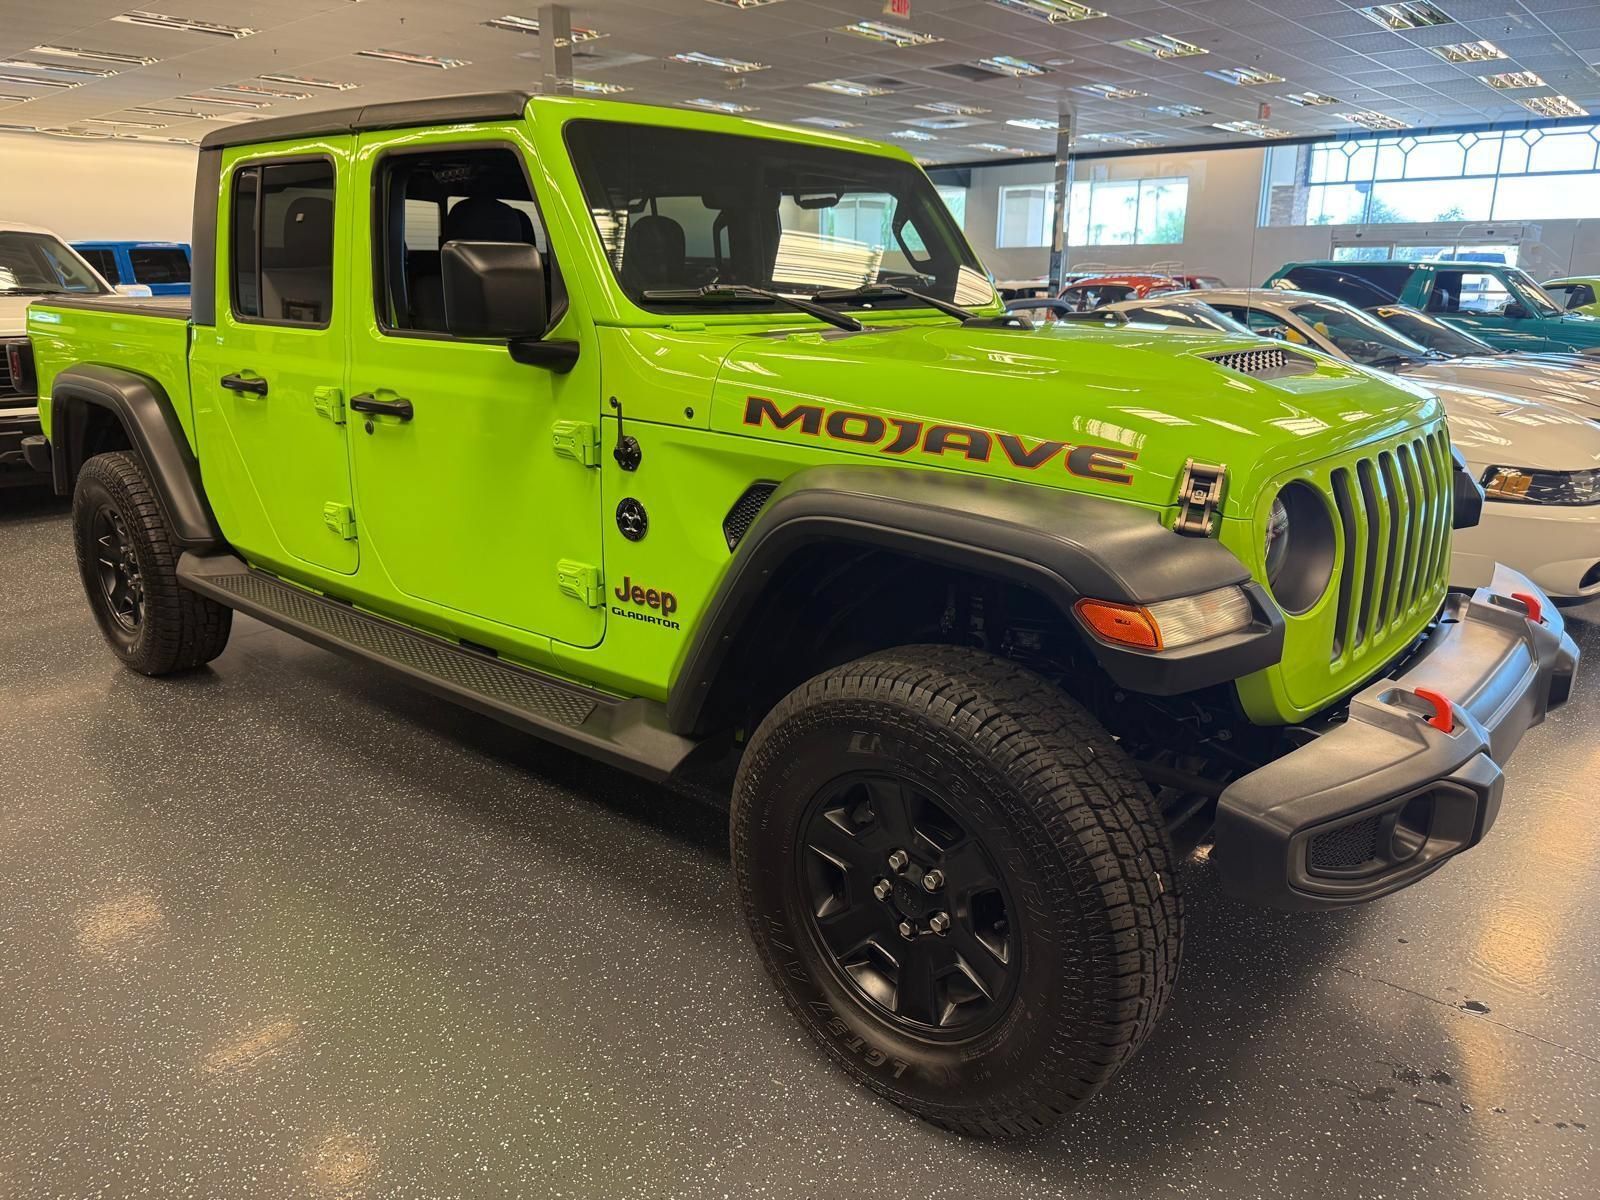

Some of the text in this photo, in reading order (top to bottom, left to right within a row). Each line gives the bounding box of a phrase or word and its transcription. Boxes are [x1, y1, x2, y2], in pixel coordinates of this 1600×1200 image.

[743, 396, 1138, 486] MOJAVE
[615, 576, 677, 617] Jeep
[612, 606, 680, 630] GLADIATOR
